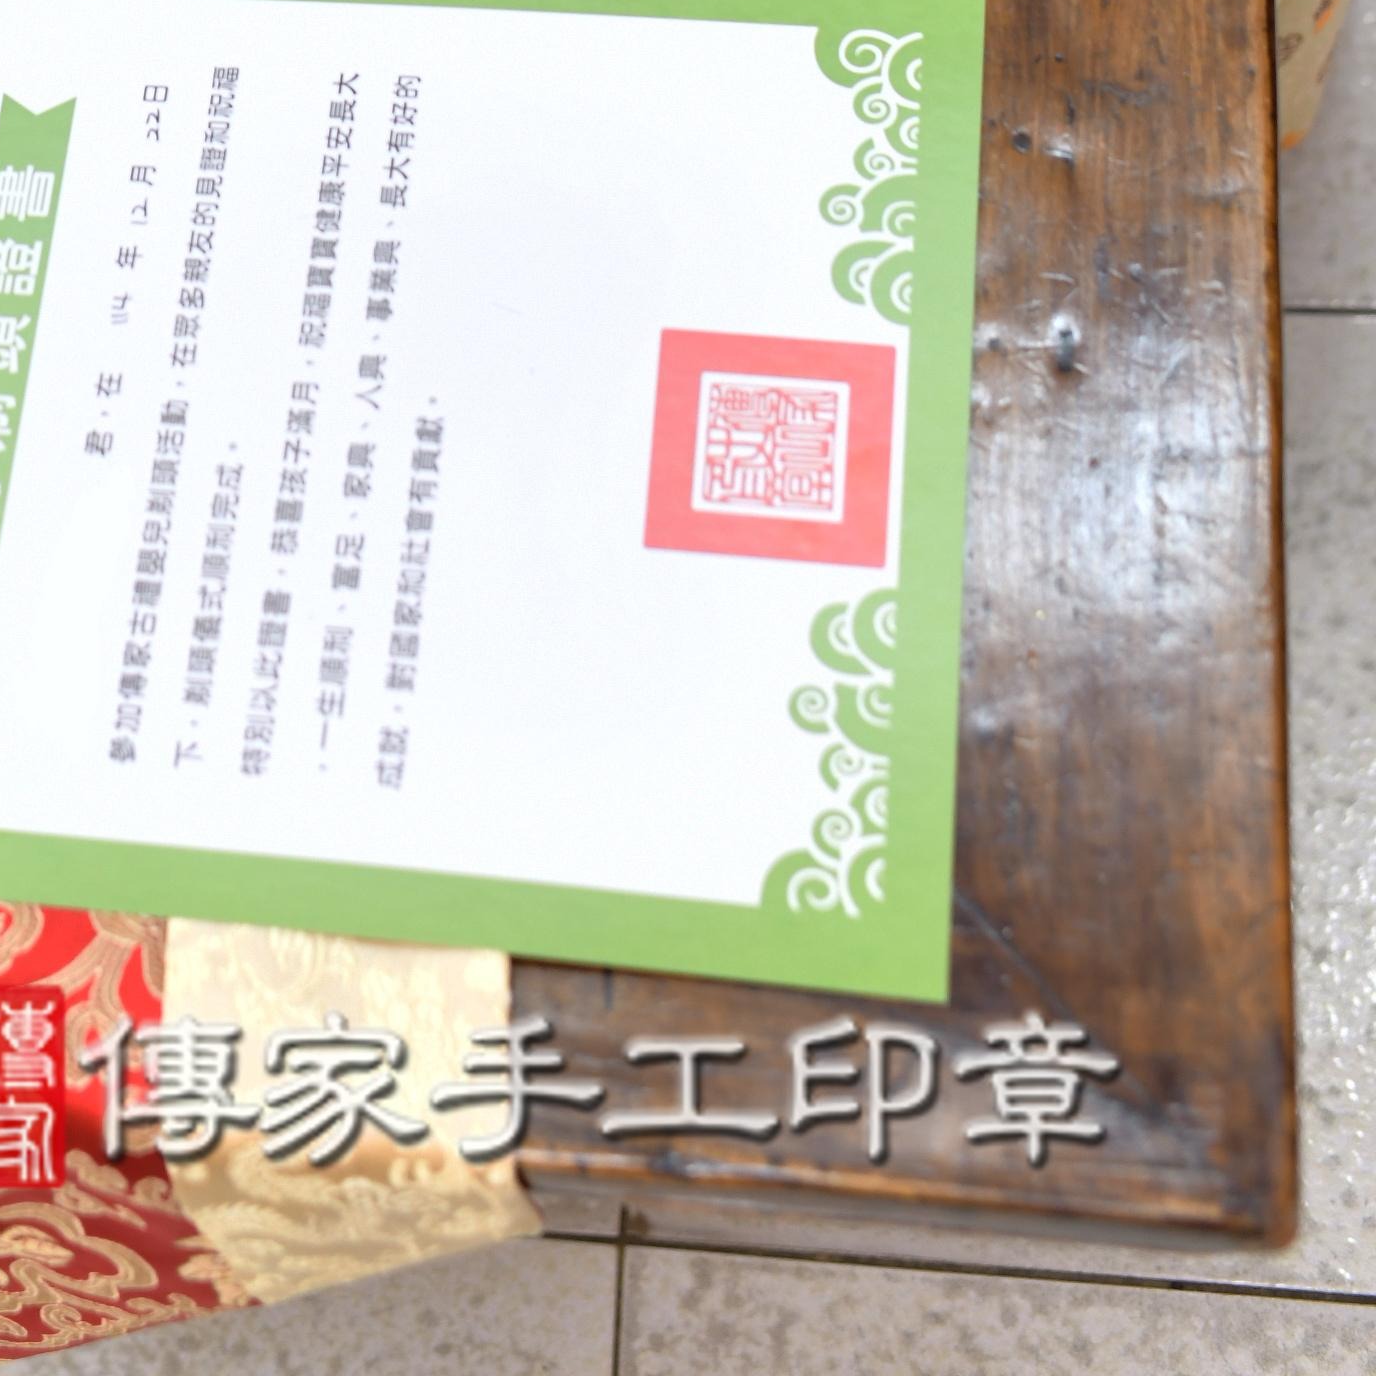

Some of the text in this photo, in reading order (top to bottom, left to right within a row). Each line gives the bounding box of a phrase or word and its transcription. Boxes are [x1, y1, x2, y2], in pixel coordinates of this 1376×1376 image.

[129, 163, 157, 186] 月
[131, 197, 150, 226] 12
[116, 244, 143, 270] 年
